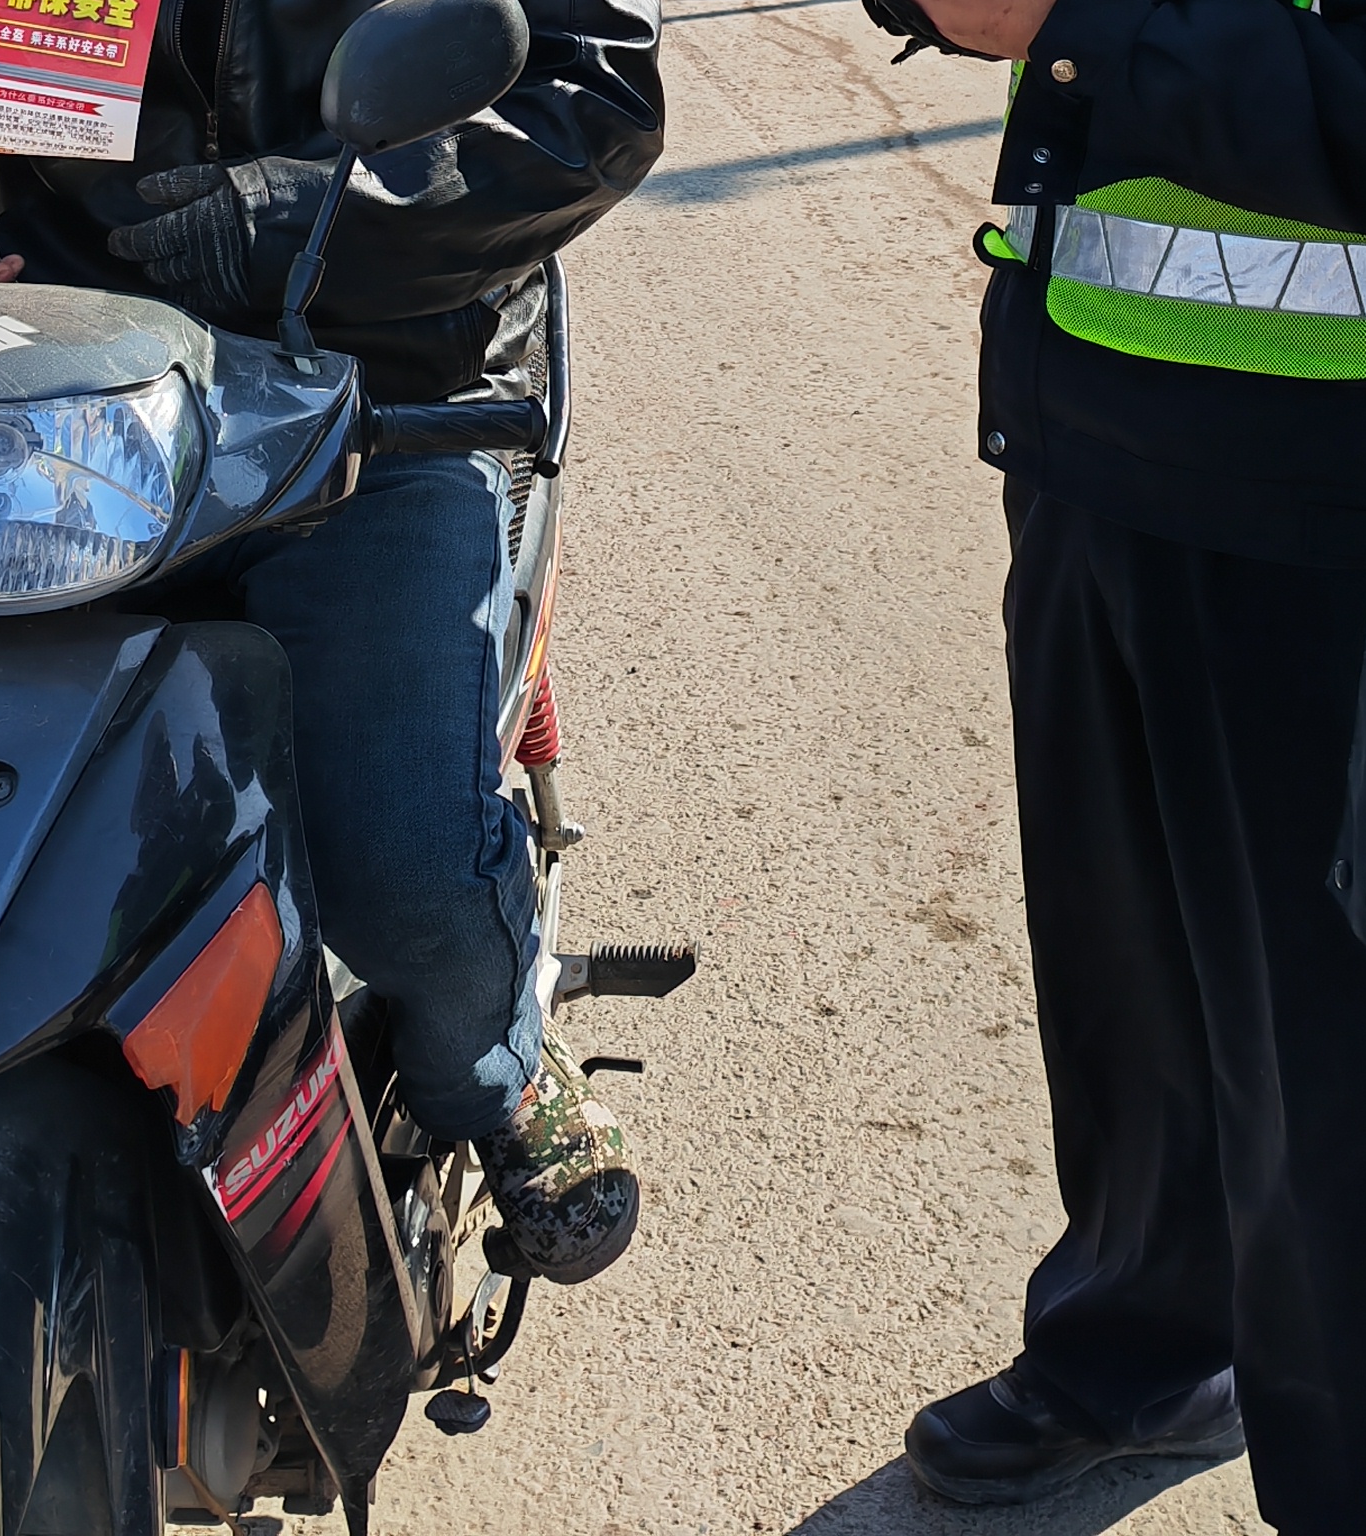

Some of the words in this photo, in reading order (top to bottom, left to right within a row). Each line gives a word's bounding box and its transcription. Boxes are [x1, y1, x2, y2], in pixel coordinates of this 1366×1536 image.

[30, 31, 119, 58] 乘车系好安全带
[225, 1035, 342, 1195] SUZUKI
